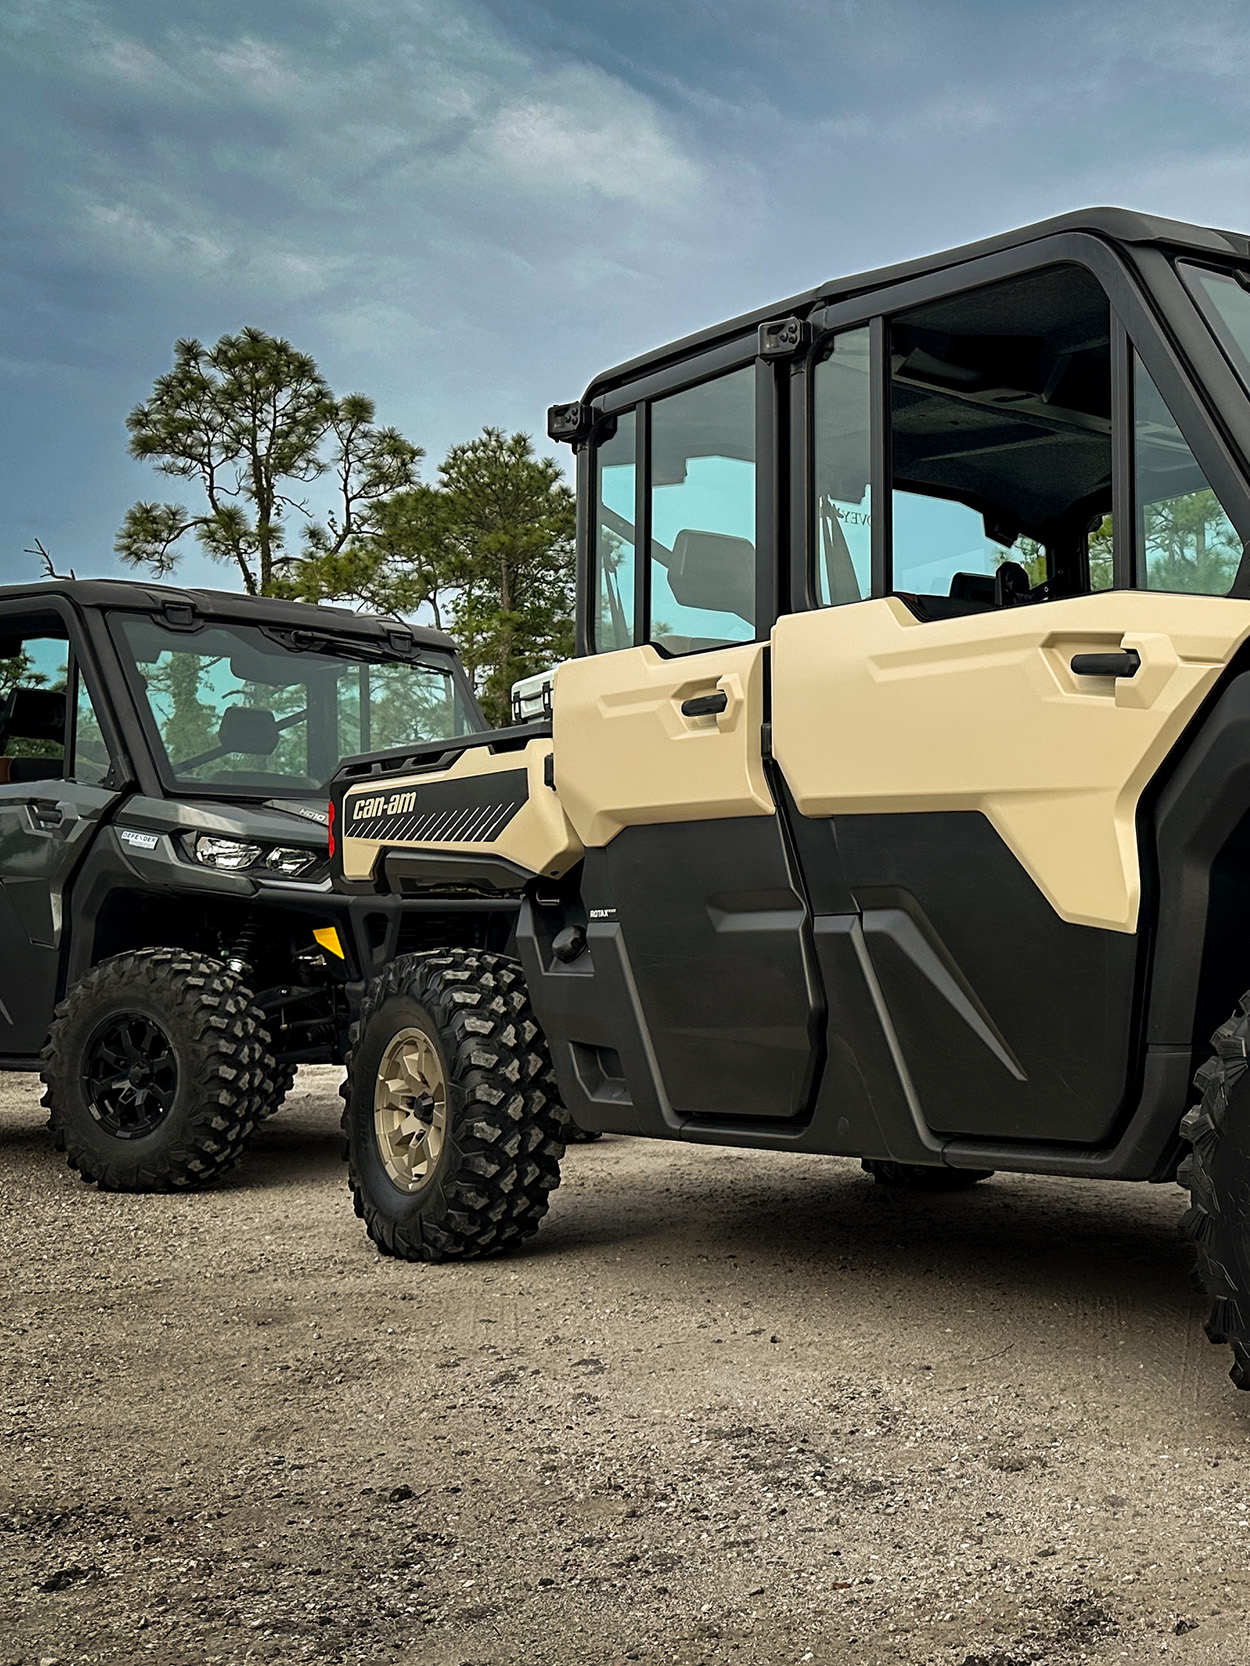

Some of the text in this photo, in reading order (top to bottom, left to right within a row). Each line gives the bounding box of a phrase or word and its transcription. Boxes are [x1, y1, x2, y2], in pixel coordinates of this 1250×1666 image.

[353, 791, 417, 820] can-am
[122, 832, 157, 843] DEFENDER
[590, 909, 609, 918] ROTAX
